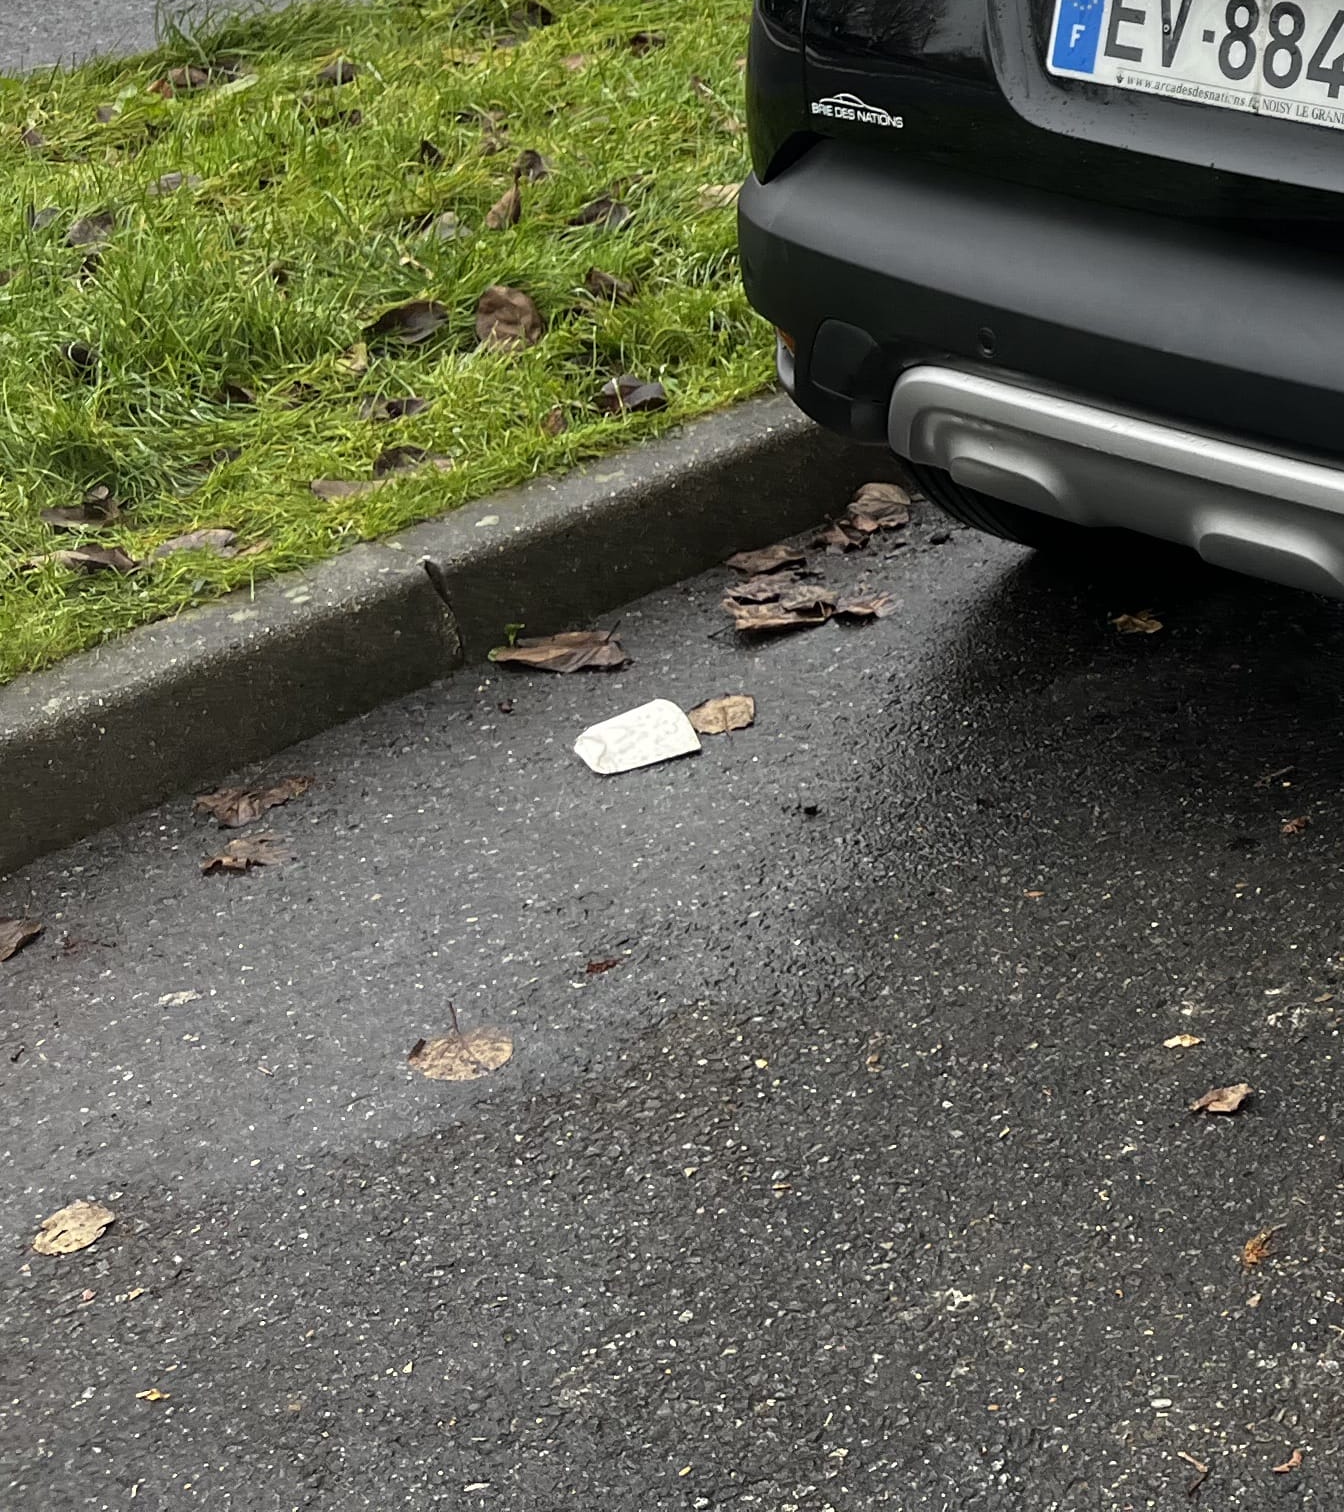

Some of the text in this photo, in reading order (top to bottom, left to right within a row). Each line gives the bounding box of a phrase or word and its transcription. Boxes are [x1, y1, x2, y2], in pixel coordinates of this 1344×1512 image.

[1069, 24, 1085, 48] F
[834, 106, 856, 120] DES
[857, 110, 904, 128] NATIONS
[1263, 98, 1293, 115] NOISY
[1296, 104, 1309, 118] LE
